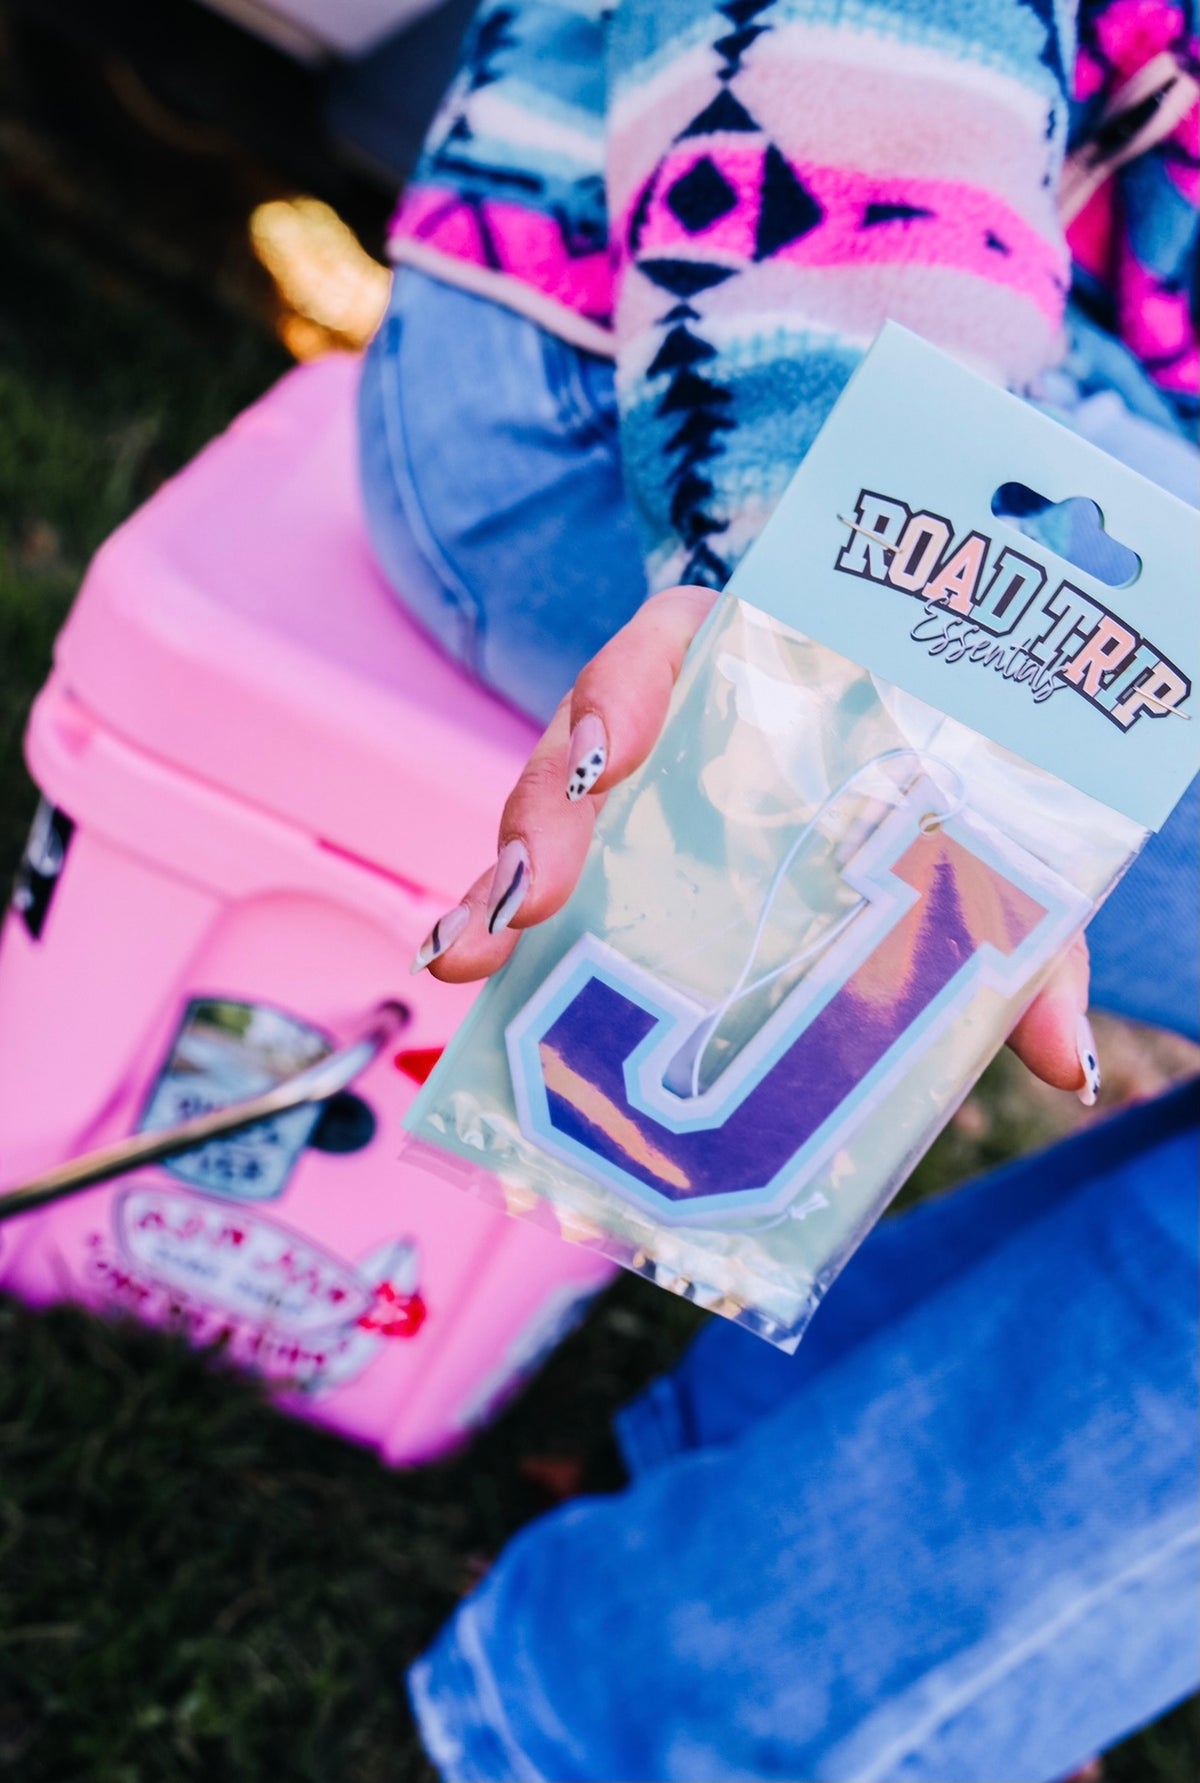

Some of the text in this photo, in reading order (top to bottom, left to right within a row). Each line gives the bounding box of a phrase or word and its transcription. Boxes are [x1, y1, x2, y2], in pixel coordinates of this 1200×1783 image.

[834, 488, 1192, 733] ROAD TRIP
[911, 597, 1068, 703] Essentials
[515, 805, 1078, 1217] J
